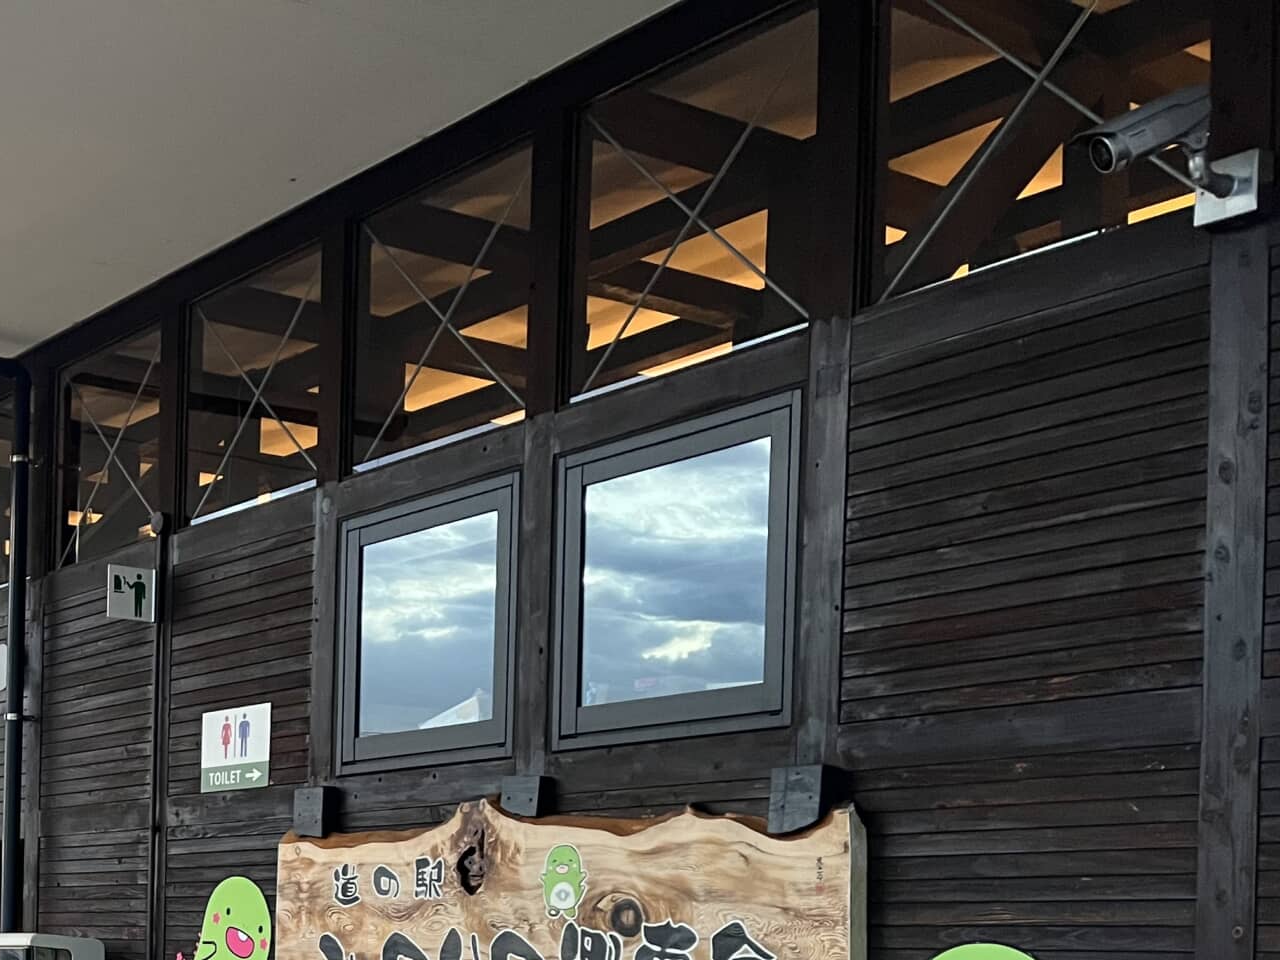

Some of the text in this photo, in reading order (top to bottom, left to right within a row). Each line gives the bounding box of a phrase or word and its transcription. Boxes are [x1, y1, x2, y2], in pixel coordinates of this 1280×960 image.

[208, 769, 242, 786] TOILET
[332, 855, 445, 907] 道の駅
